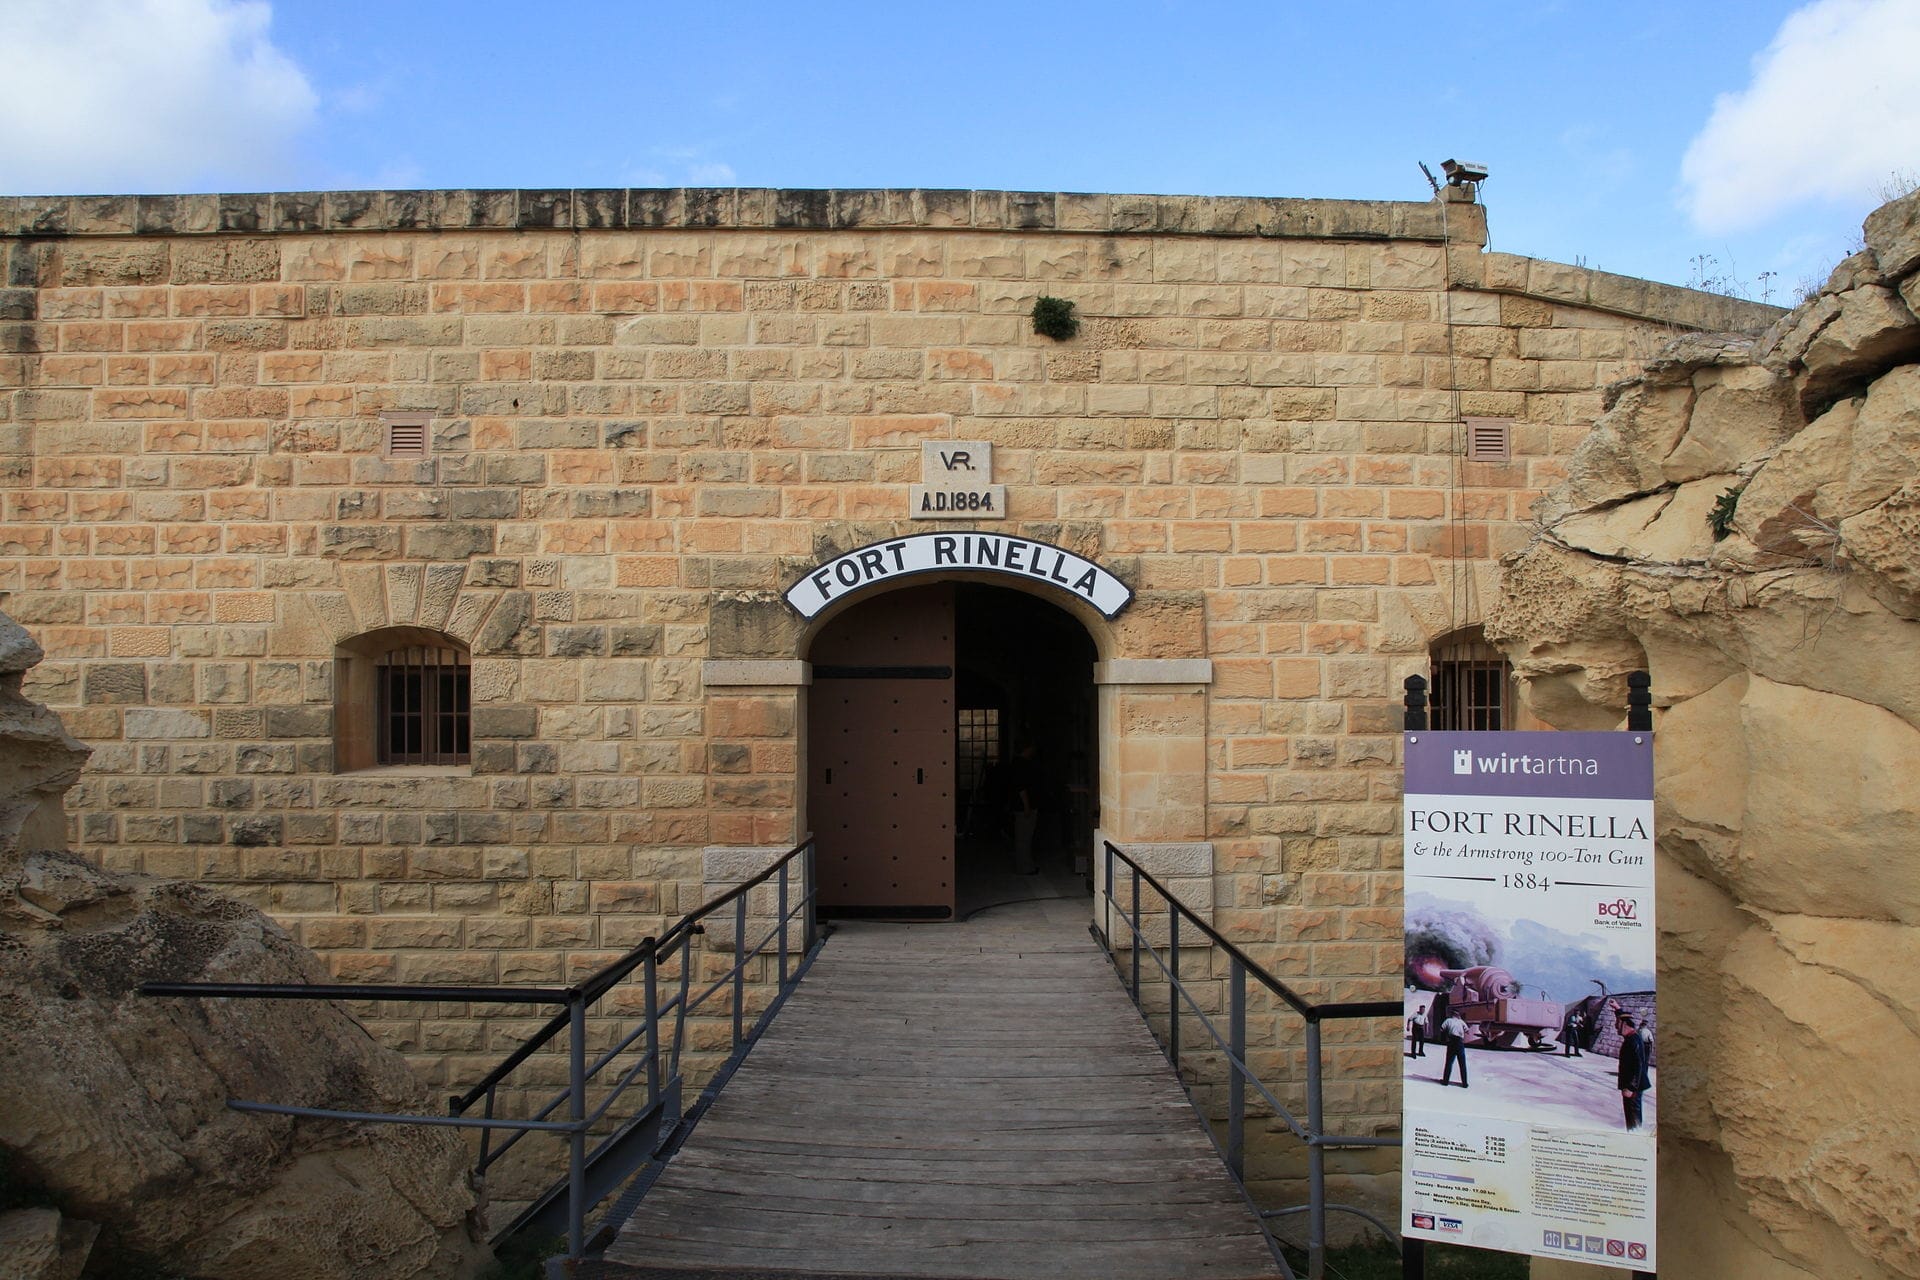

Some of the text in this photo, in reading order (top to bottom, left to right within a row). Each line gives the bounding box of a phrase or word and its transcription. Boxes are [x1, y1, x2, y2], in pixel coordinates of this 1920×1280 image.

[811, 536, 1099, 600] FORT RINELLA
[1478, 752, 1598, 775] wirtartna
[1410, 810, 1648, 840] FORT RINELLA
[1413, 841, 1643, 865] & the Armstrong 100-Ton Gun
[1503, 873, 1550, 892] 1884
